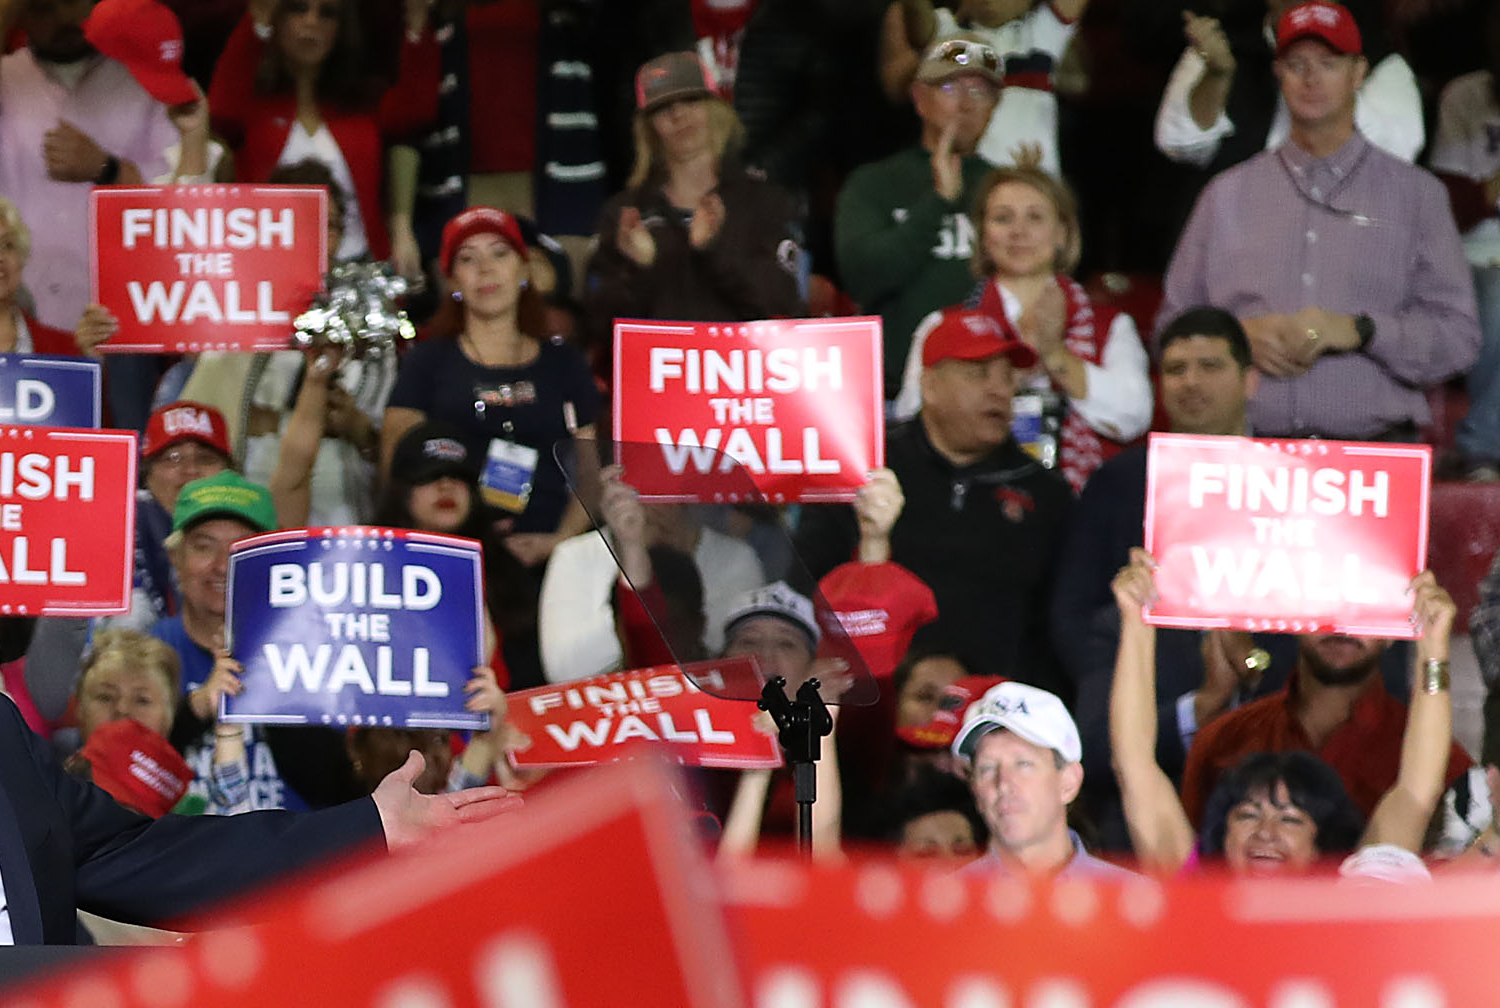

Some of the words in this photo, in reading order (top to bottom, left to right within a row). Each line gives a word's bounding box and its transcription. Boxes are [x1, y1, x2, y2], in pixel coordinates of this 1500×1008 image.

[122, 208, 294, 250] FINISH
[176, 252, 233, 275] THE
[127, 281, 289, 325] WALL
[649, 346, 843, 393] FINISH
[709, 397, 773, 425] THE
[655, 429, 841, 475] WALL
[1188, 464, 1389, 517] FINISH
[1252, 516, 1317, 547] THE
[268, 562, 443, 611] BUILD
[1193, 547, 1377, 600] WALL
[325, 612, 390, 641] THE
[263, 643, 449, 698] WALL
[529, 669, 726, 715] FINISH
[546, 709, 735, 750] WALL
[601, 697, 662, 718] THE
